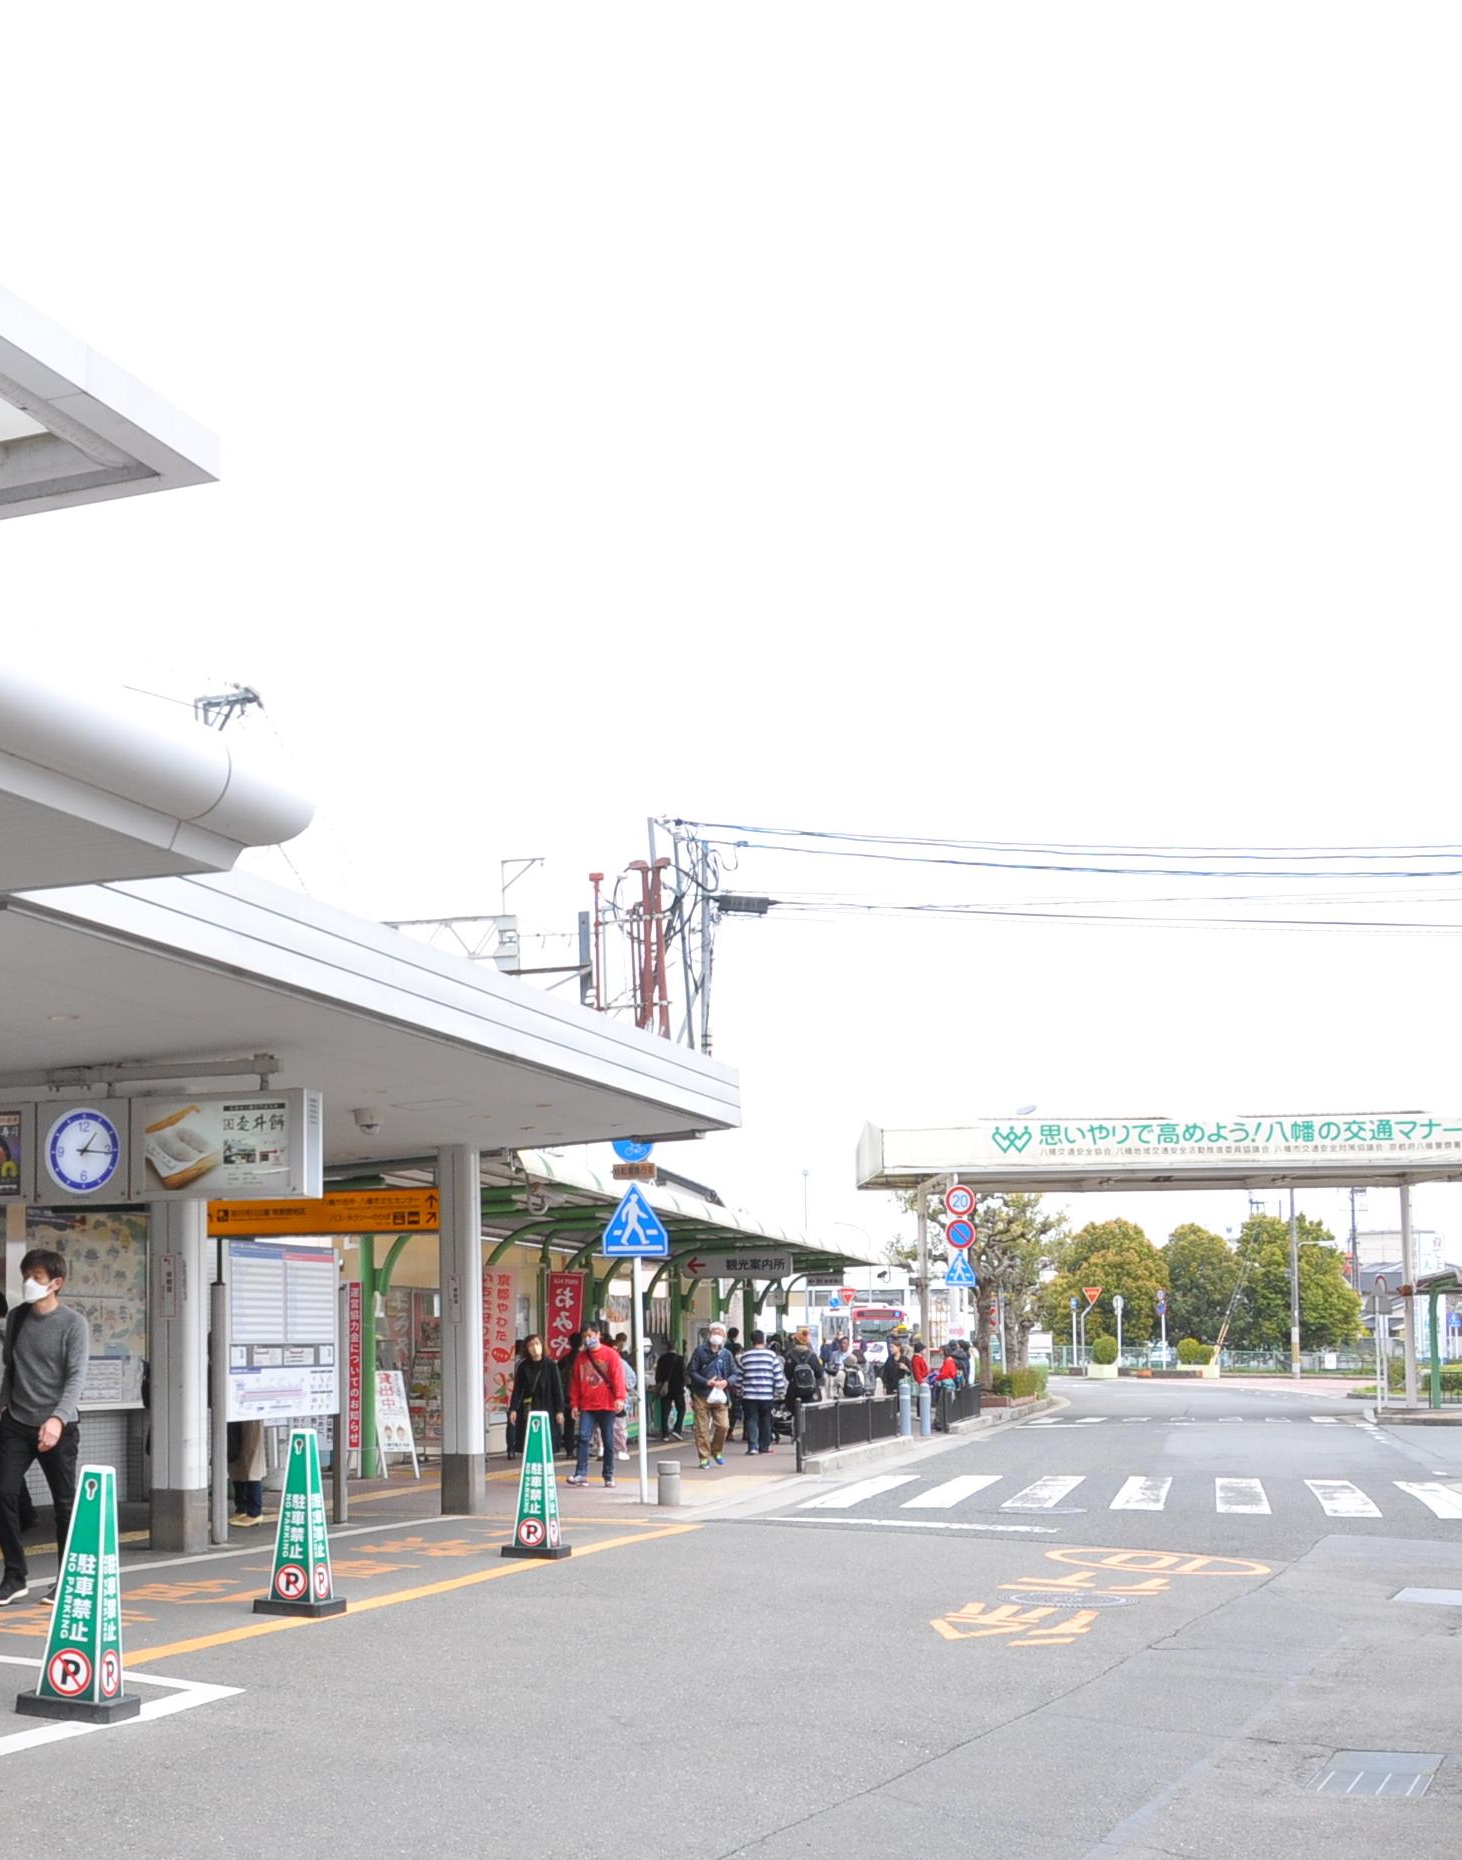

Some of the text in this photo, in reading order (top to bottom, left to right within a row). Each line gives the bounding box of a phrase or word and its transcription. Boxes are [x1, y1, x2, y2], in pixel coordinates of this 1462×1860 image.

[78, 1121, 90, 1133] 12
[57, 1146, 65, 1158] 9
[80, 1170, 88, 1182] 6
[952, 1194, 969, 1208] 20
[725, 1257, 786, 1272] 観光案内所
[495, 1273, 513, 1342] 京都やわた
[349, 1287, 361, 1444] 運営協力金についてのお知らせ
[378, 1372, 396, 1410] 貸出中
[289, 1493, 306, 1559] 駐車禁止
[59, 1552, 78, 1639] NO PARKING
[68, 1553, 97, 1642] 駐車禁止
